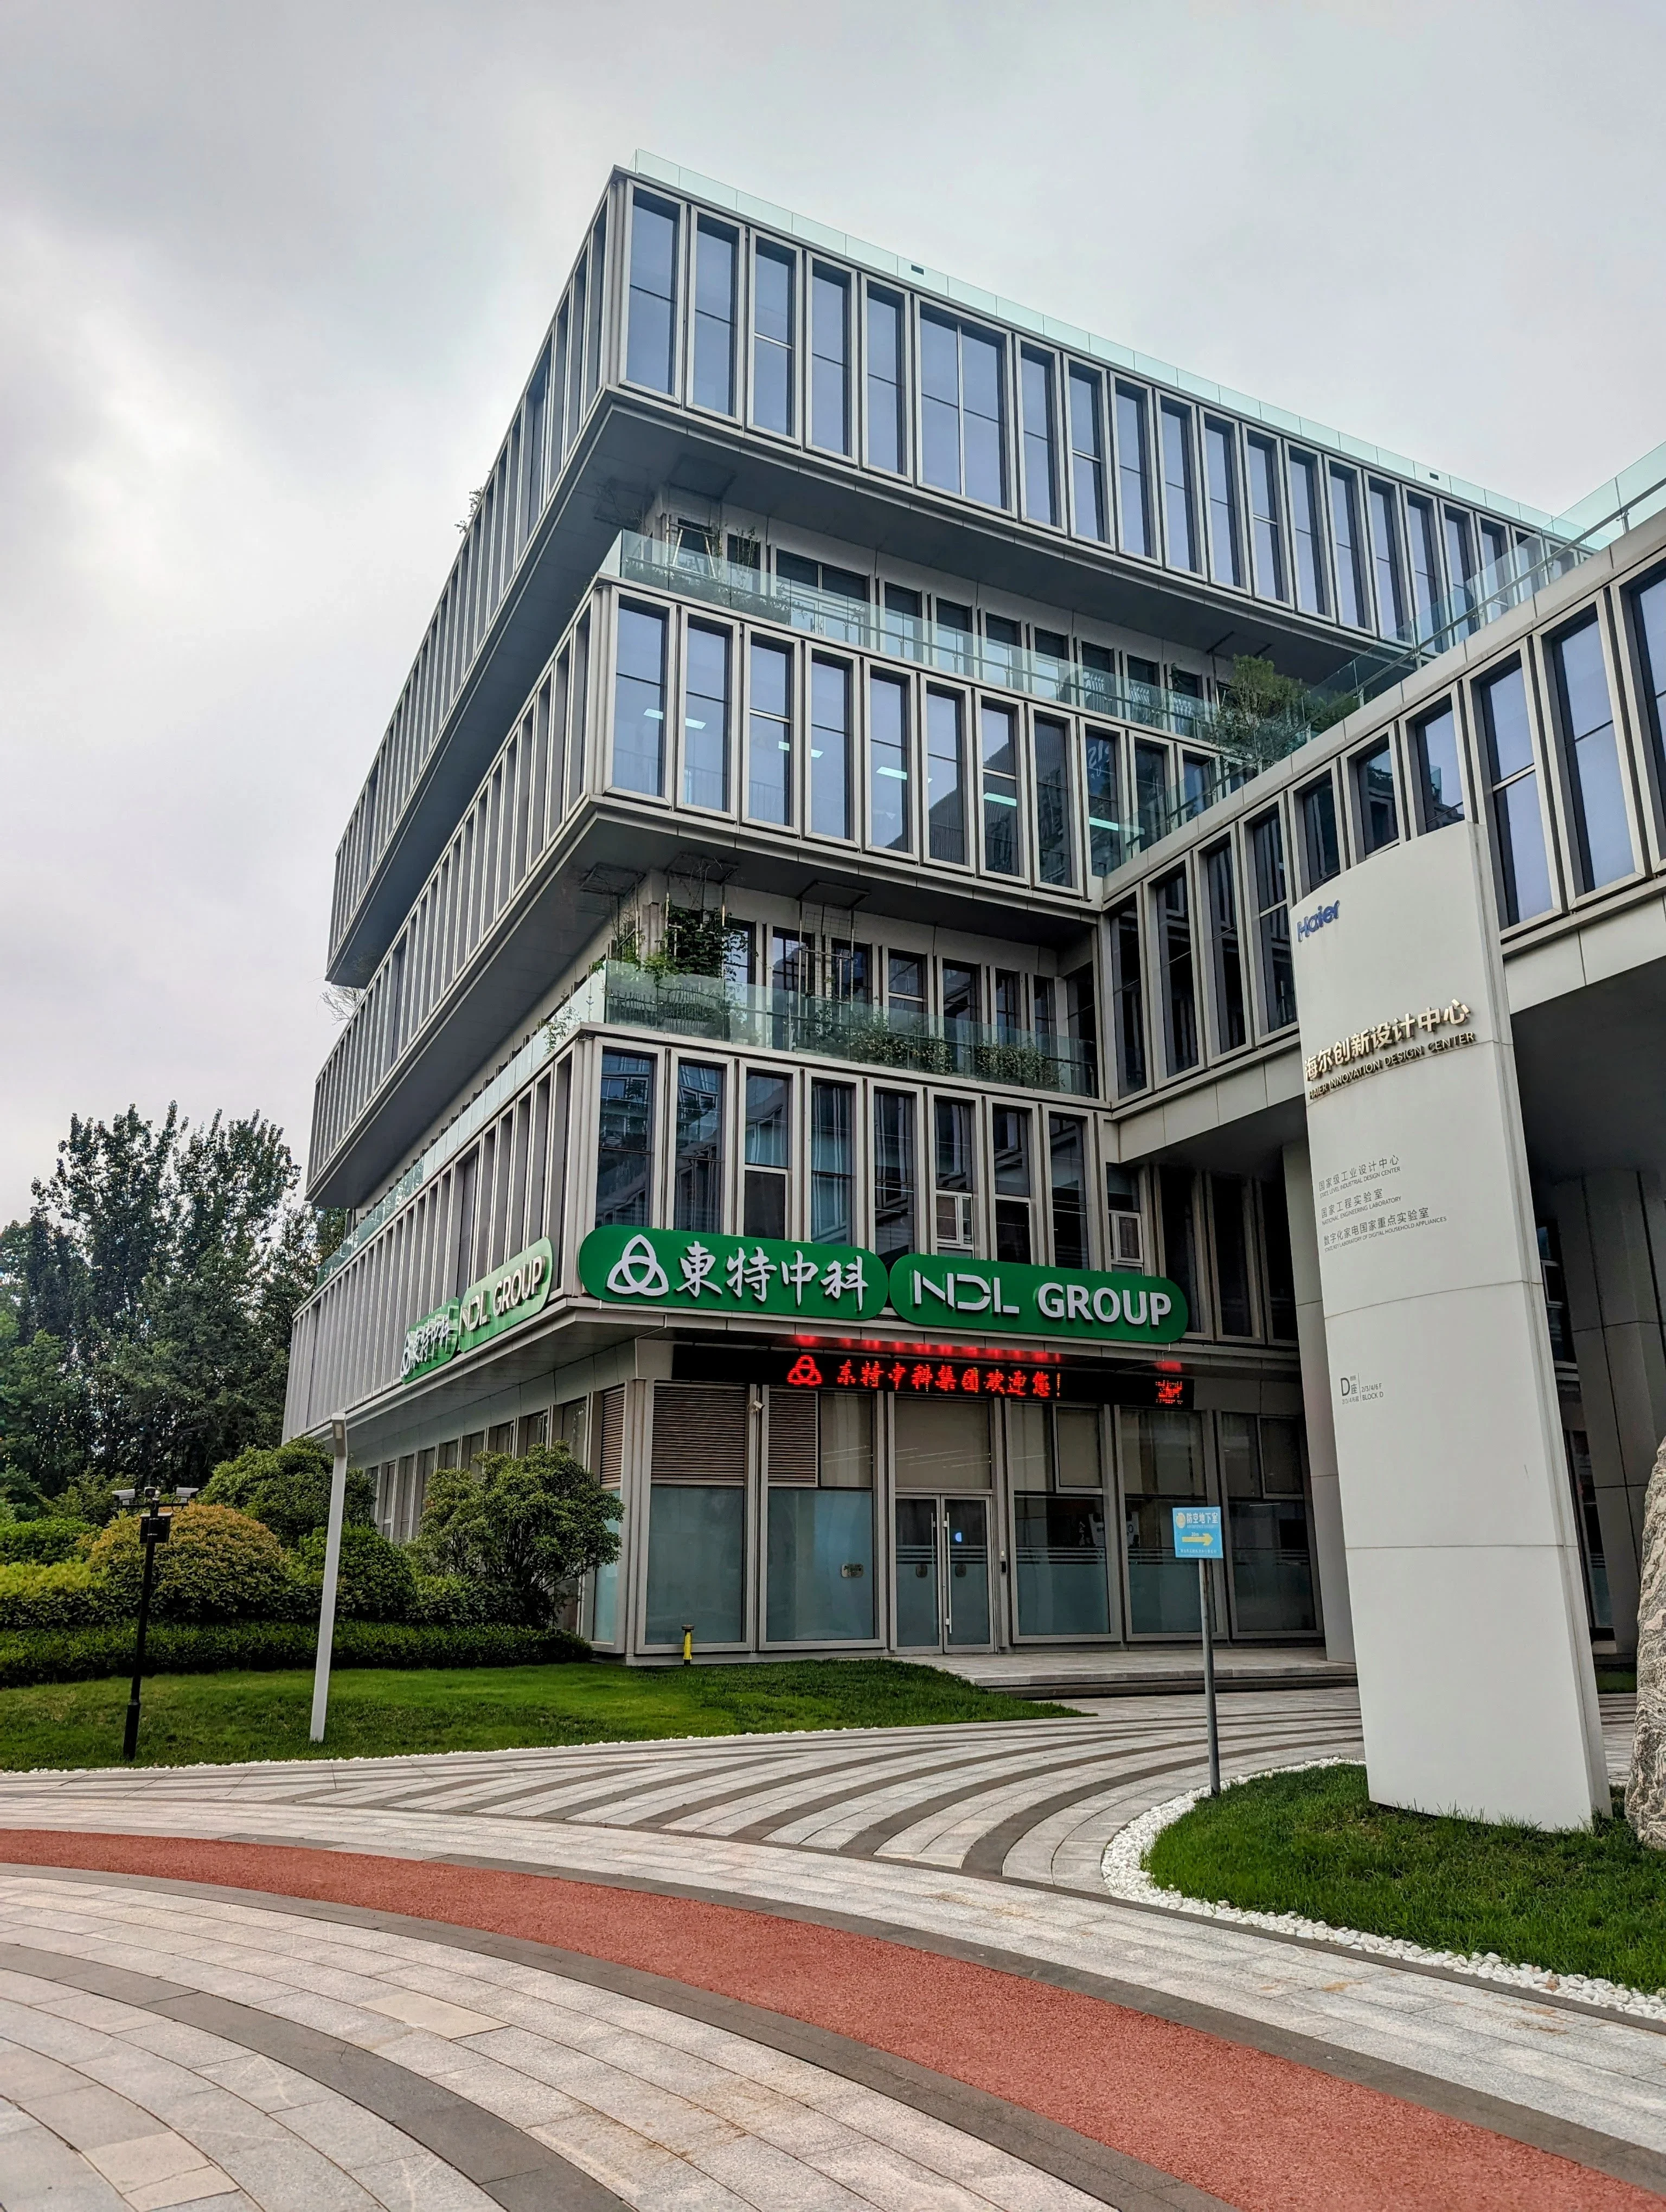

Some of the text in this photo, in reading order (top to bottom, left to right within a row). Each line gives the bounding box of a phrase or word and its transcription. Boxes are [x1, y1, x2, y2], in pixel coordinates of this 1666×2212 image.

[1297, 900, 1340, 942] Haier
[1305, 999, 1470, 1081] 海尔创新设计中心
[1309, 1032, 1475, 1099] HAIER INNOVATION DESIGN CENTER
[1319, 1155, 1399, 1192] 国家级工业设计中心
[1319, 1166, 1401, 1199] STATE LEVEL INDUSTRIAL DESIGN CENTER
[1321, 1188, 1383, 1218] 国家工程实验室
[1322, 1196, 1401, 1225] NATIONAL ENGINEERING LABORATORY
[1324, 1207, 1429, 1246] 数字化家电国家重点实验室
[1339, 1236, 1362, 1247] LABORATORY
[1368, 1230, 1385, 1239] DIGITAL
[1385, 1223, 1415, 1234] HOUSEHOLD
[1415, 1216, 1447, 1227] APPLIANCES
[493, 1256, 544, 1316] GROUP
[676, 1240, 869, 1311] 東特中科
[914, 1269, 1171, 1326] NDL GROUP
[1362, 1392, 1378, 1401] BLOCK
[1186, 1512, 1219, 1524] 防空地下室
